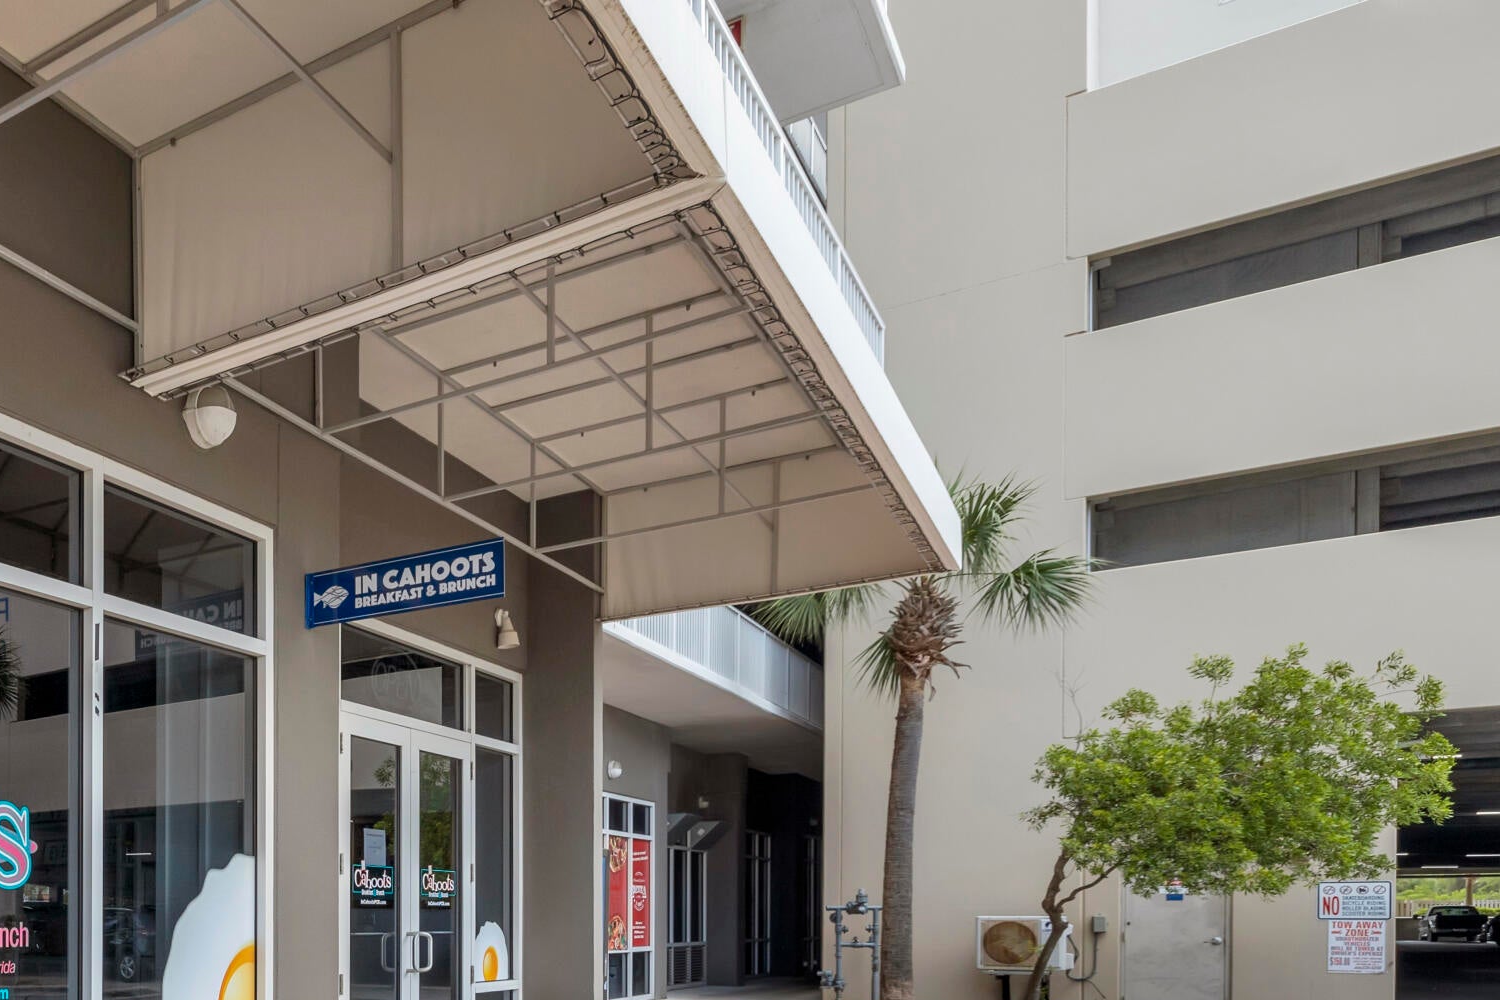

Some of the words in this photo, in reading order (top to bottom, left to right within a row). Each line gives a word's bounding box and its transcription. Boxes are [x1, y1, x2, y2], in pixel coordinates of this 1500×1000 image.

[355, 573, 378, 595] IN
[383, 551, 496, 587] CAHOOTS
[355, 586, 423, 609] BREAKFAST
[426, 585, 437, 597] &
[439, 574, 496, 595] BRUNCH
[354, 868, 392, 889] Cahoots
[422, 873, 455, 892] Cahoots
[1323, 896, 1340, 916] NO
